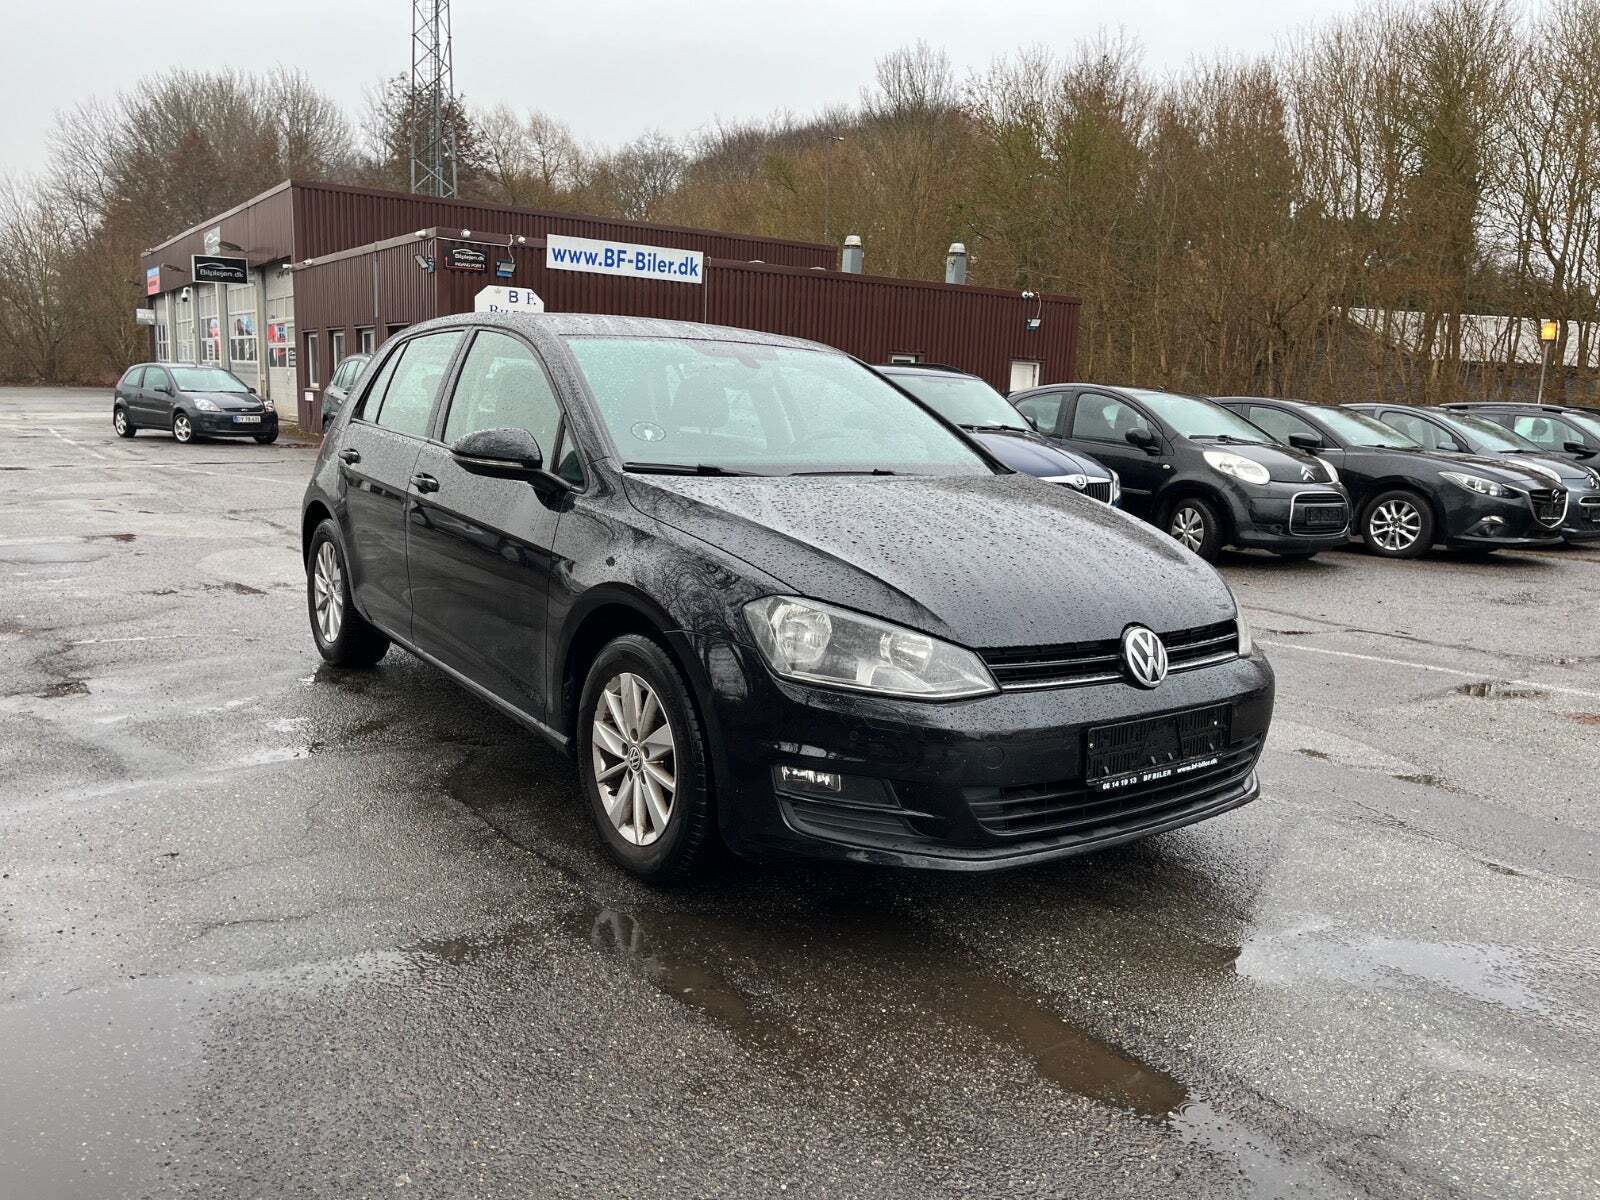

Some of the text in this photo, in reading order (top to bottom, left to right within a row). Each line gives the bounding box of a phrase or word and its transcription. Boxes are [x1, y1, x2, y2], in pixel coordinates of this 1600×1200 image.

[552, 247, 699, 276] www.BF-Biler.dk
[508, 290, 519, 303] B
[1126, 627, 1168, 687] VW
[1143, 773, 1151, 782] BF
[1152, 770, 1172, 779] BILER
